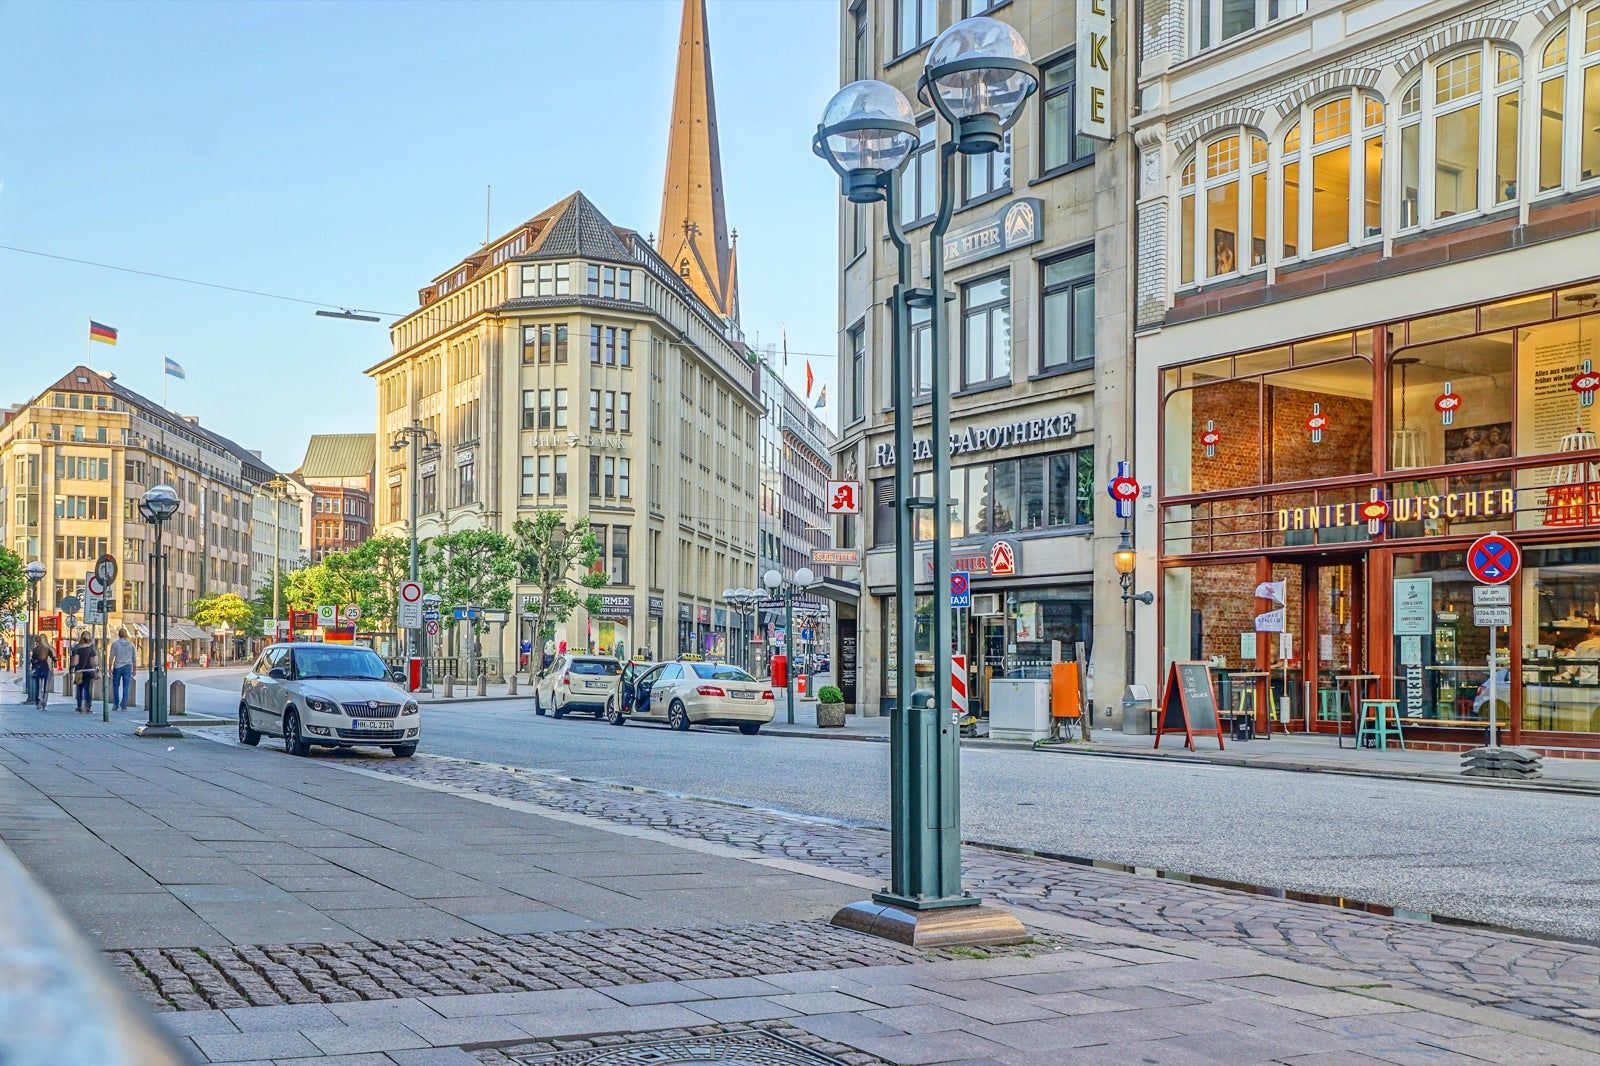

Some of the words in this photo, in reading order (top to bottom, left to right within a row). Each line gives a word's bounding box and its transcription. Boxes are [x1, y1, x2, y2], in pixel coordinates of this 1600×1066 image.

[529, 434, 561, 448] BHF
[585, 434, 626, 449] BANK
[1278, 502, 1361, 531] DANIEL
[1393, 488, 1516, 522] WISCHER
[956, 557, 988, 572] HIER
[601, 596, 629, 606] IRMER
[348, 608, 358, 617] 25
[952, 713, 959, 725] 5
